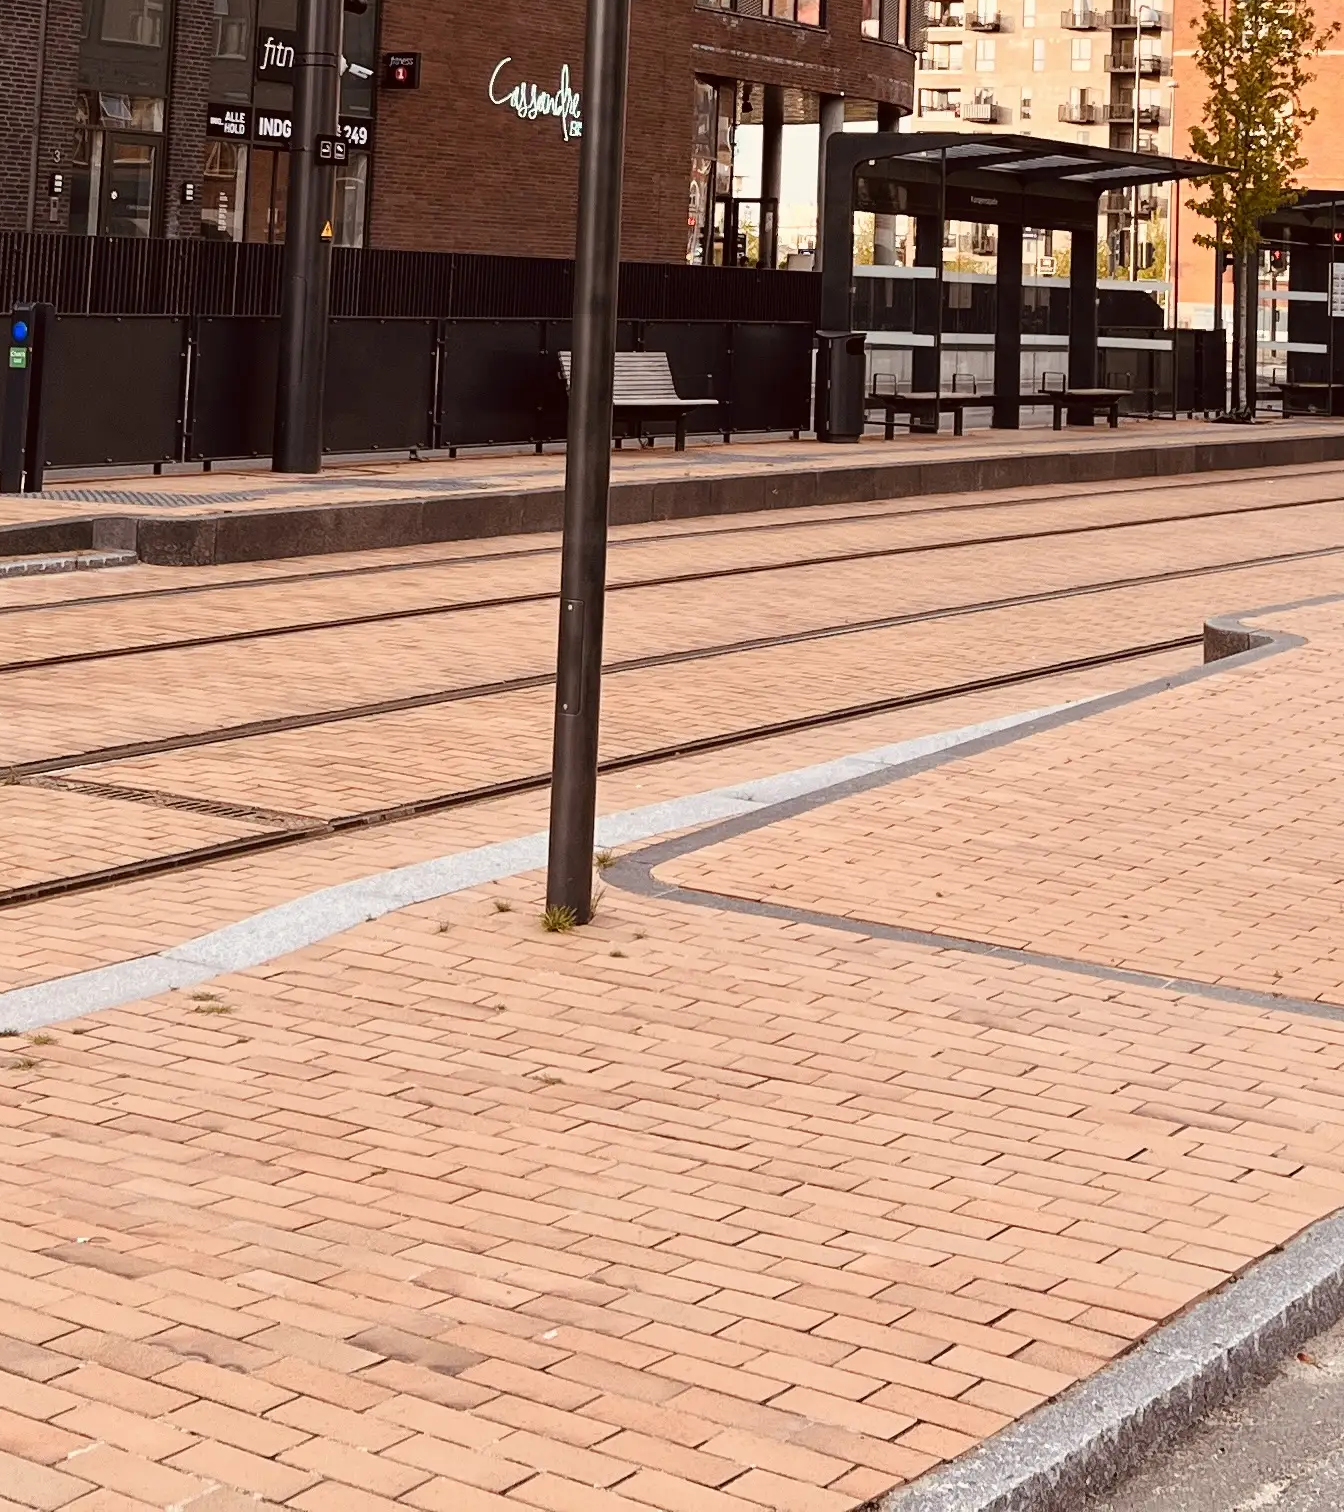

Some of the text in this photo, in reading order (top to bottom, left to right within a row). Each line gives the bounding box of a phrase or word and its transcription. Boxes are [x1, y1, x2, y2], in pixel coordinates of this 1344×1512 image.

[259, 36, 295, 70] fitn
[224, 111, 246, 123] ALLE
[258, 116, 292, 138] INDG
[223, 123, 245, 134] HOLD
[343, 125, 368, 145] 249
